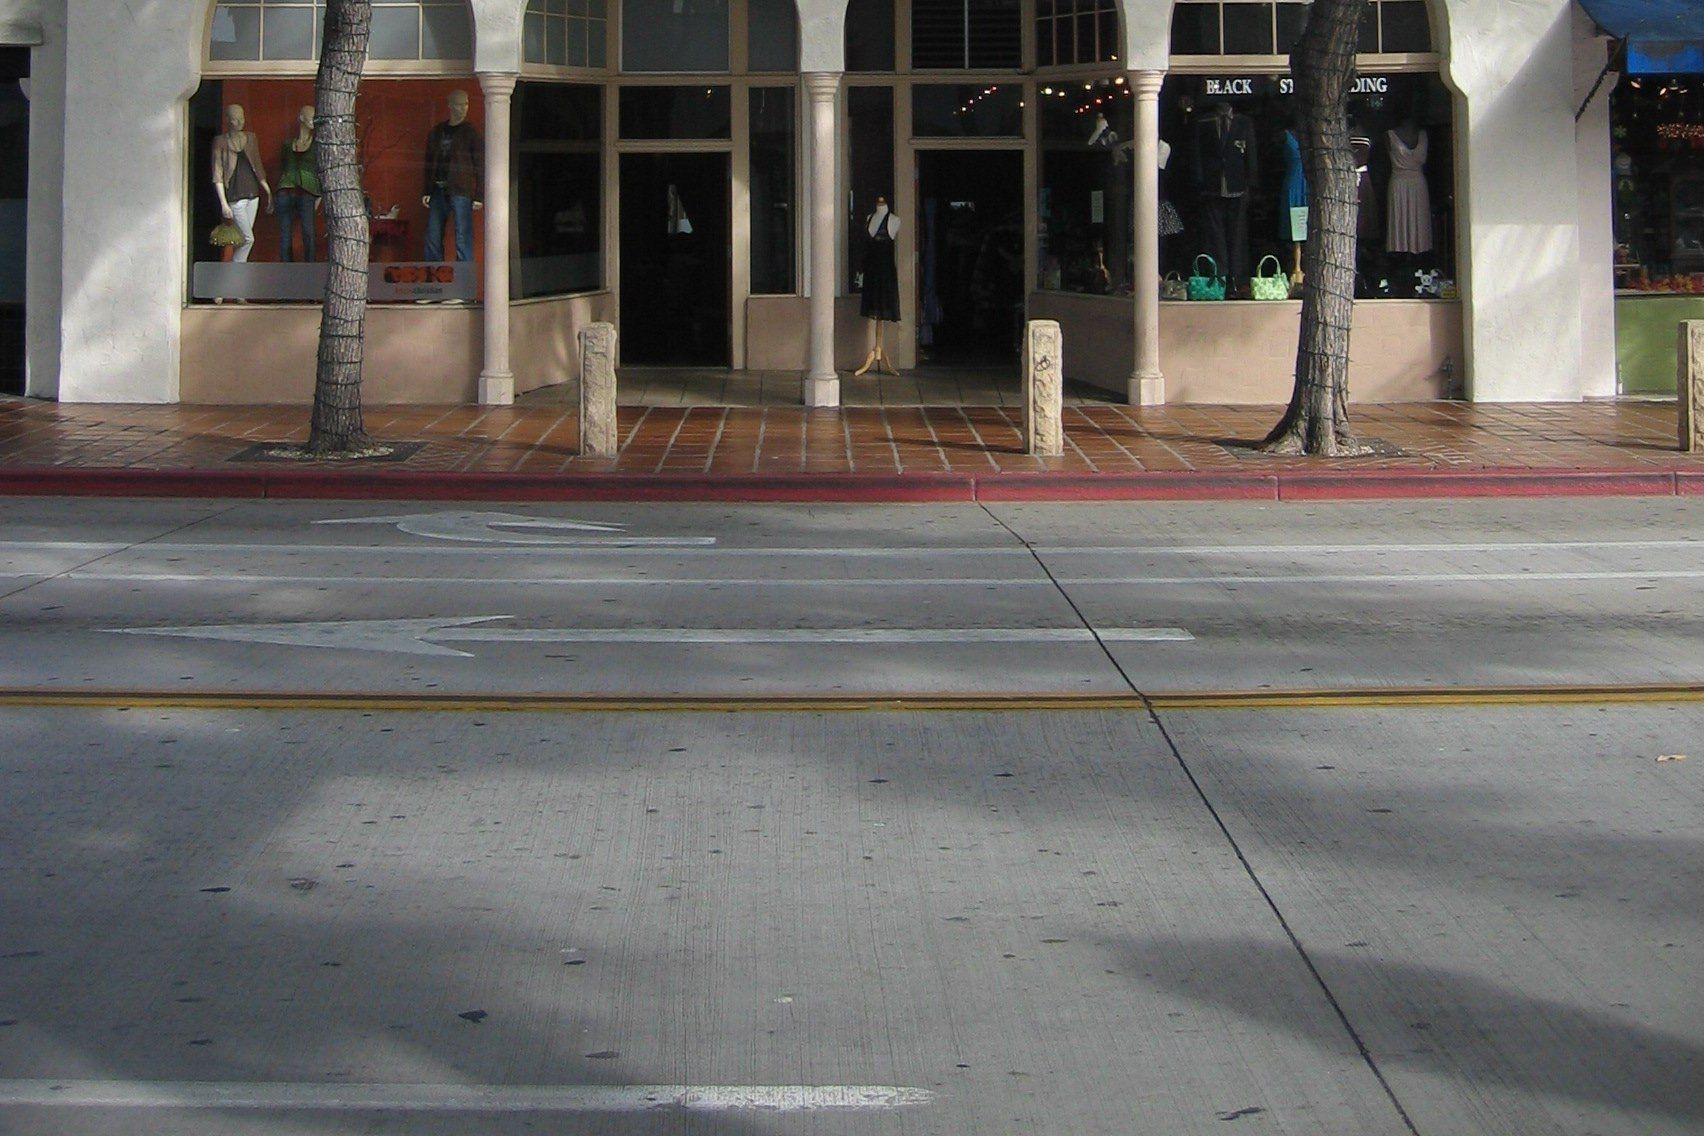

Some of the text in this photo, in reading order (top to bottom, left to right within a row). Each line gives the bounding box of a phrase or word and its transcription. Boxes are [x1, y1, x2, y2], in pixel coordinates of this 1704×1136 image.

[1206, 77, 1388, 94] BLACK ST DING
